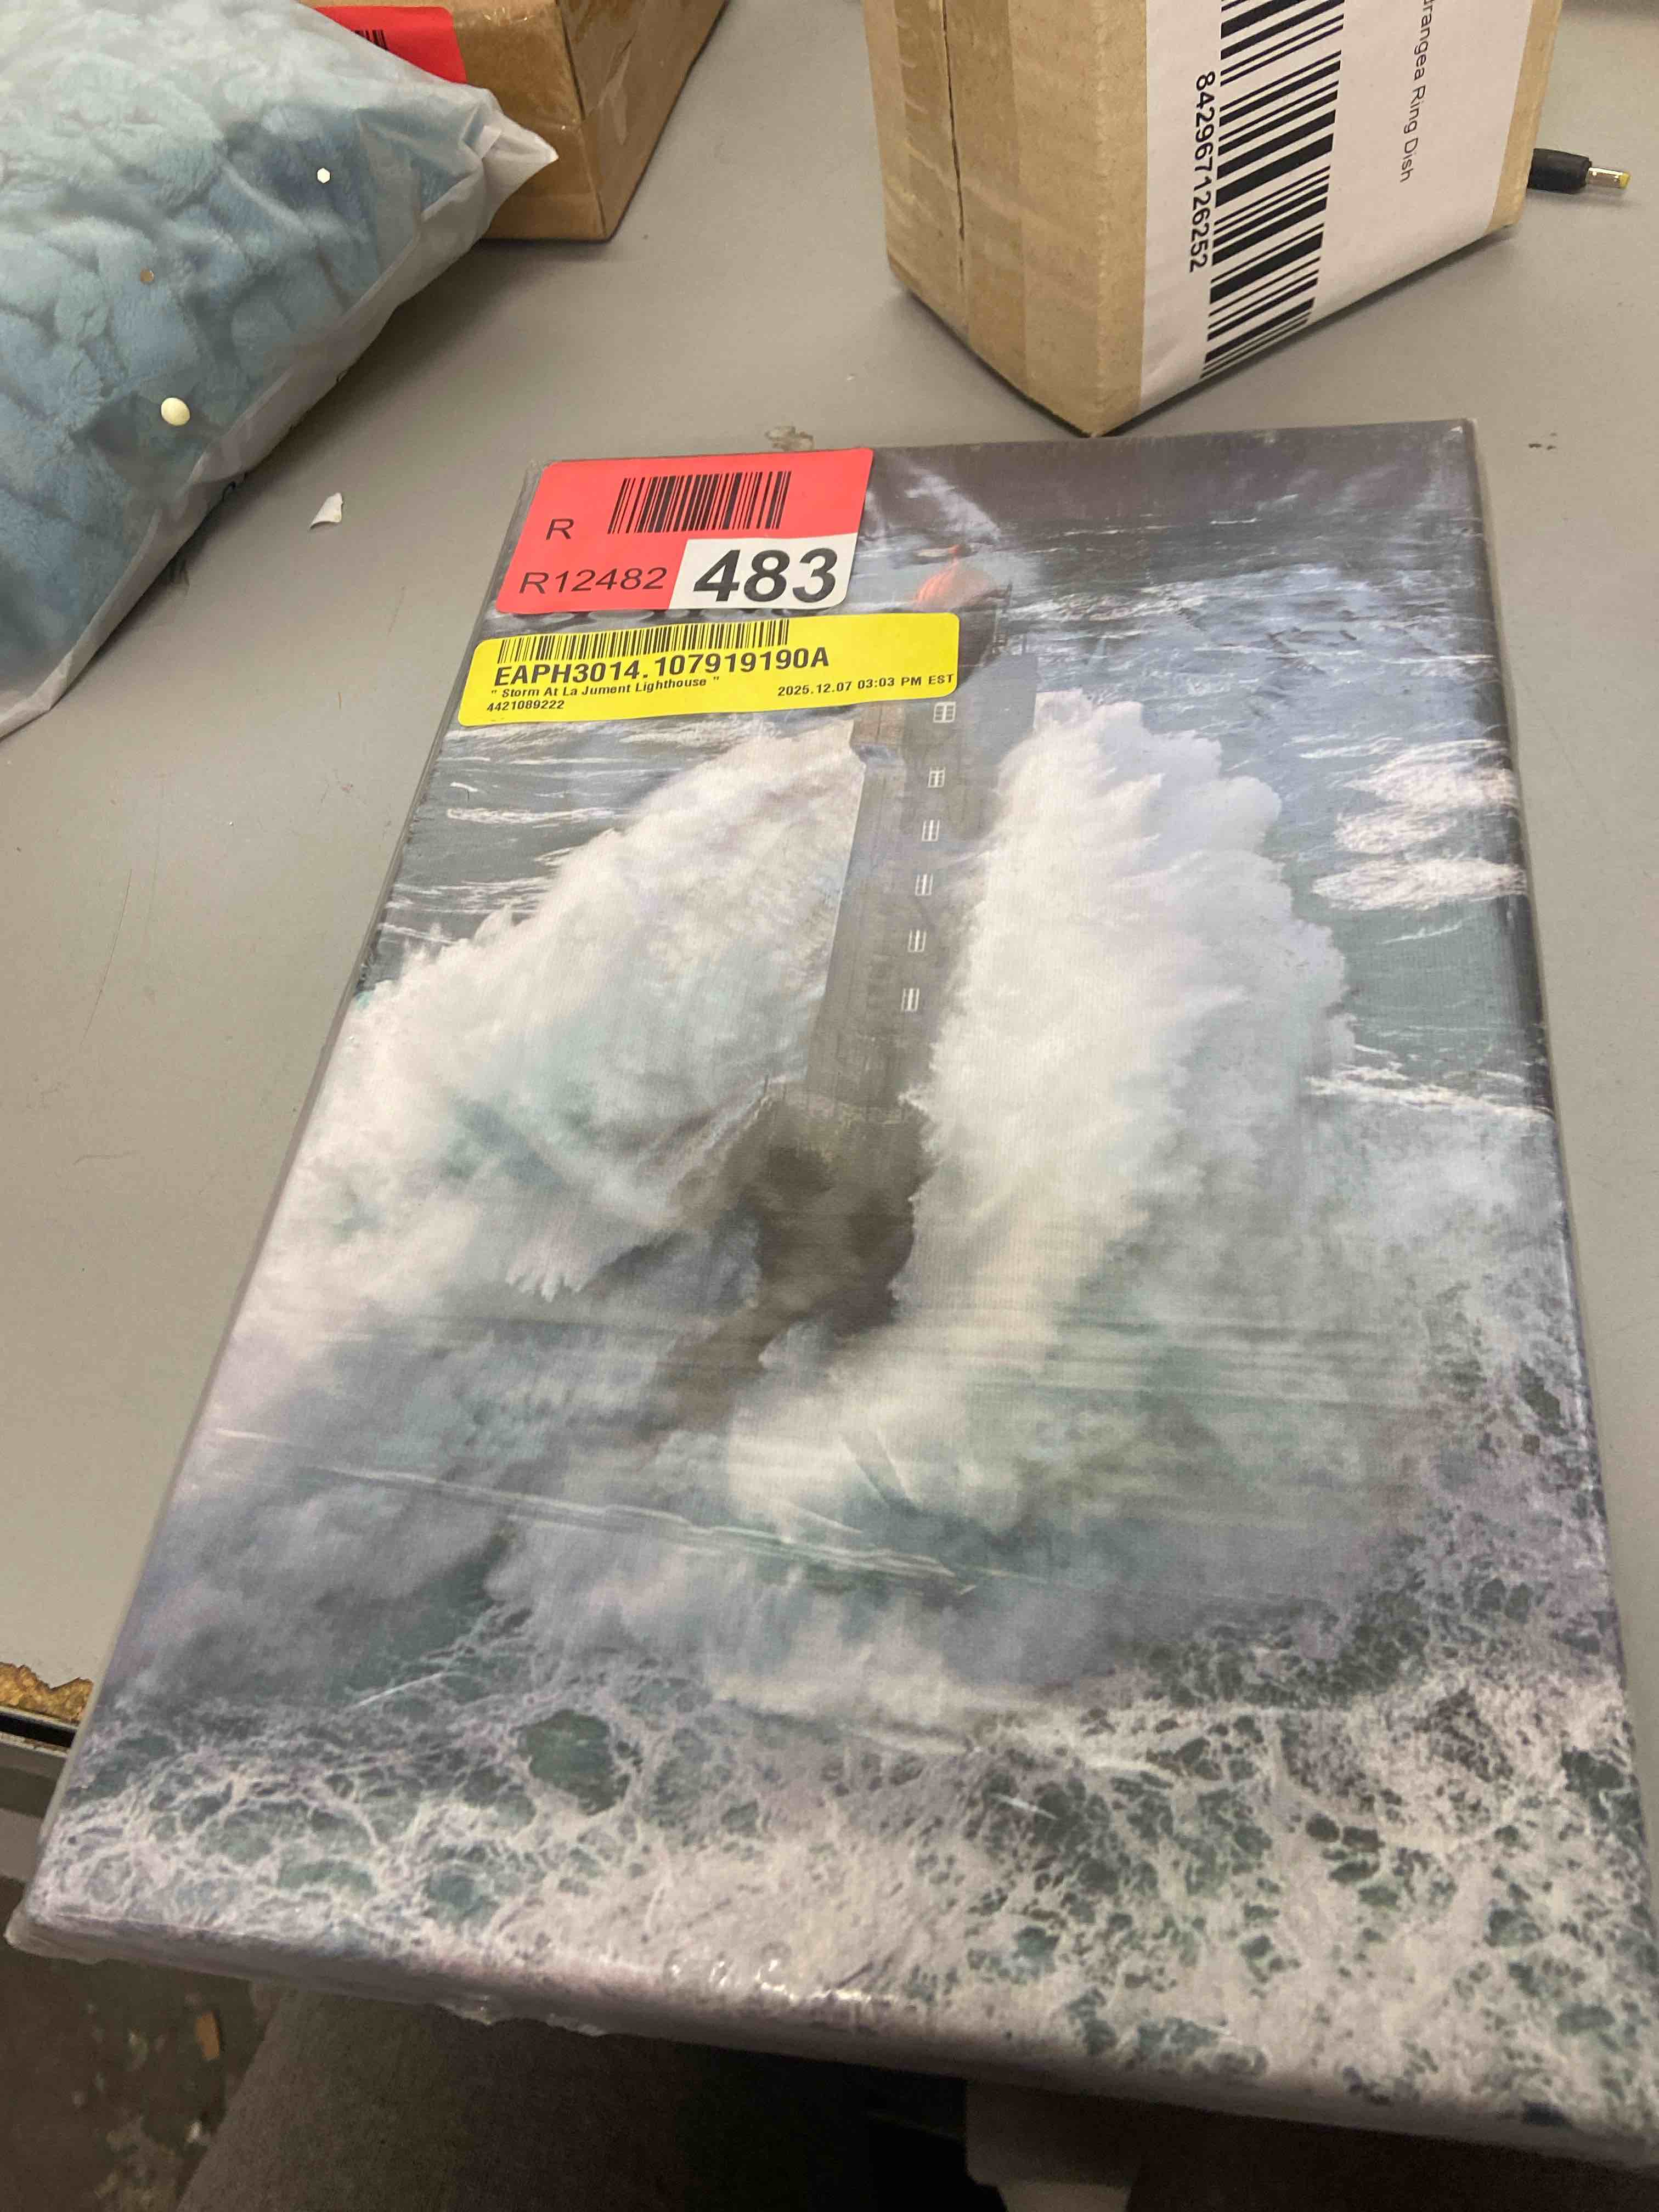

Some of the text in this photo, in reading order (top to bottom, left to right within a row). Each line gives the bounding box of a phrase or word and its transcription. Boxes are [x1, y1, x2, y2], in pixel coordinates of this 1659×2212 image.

[1404, 84, 1425, 134] Ring
[1189, 71, 1216, 273] 842967126252
[1400, 137, 1418, 183] Dish
[545, 518, 574, 540] R
[519, 567, 668, 594] R12482
[693, 548, 838, 603] 483
[494, 647, 829, 686] EAPH3014.107919190A
[502, 687, 539, 698] Storm
[544, 686, 558, 697] At
[562, 686, 578, 696] La
[582, 684, 630, 696] Jument
[635, 678, 707, 693] Lighthouse
[777, 674, 955, 697] 2025.12.07 03:03 PM EST
[487, 699, 565, 712] 4421089222
